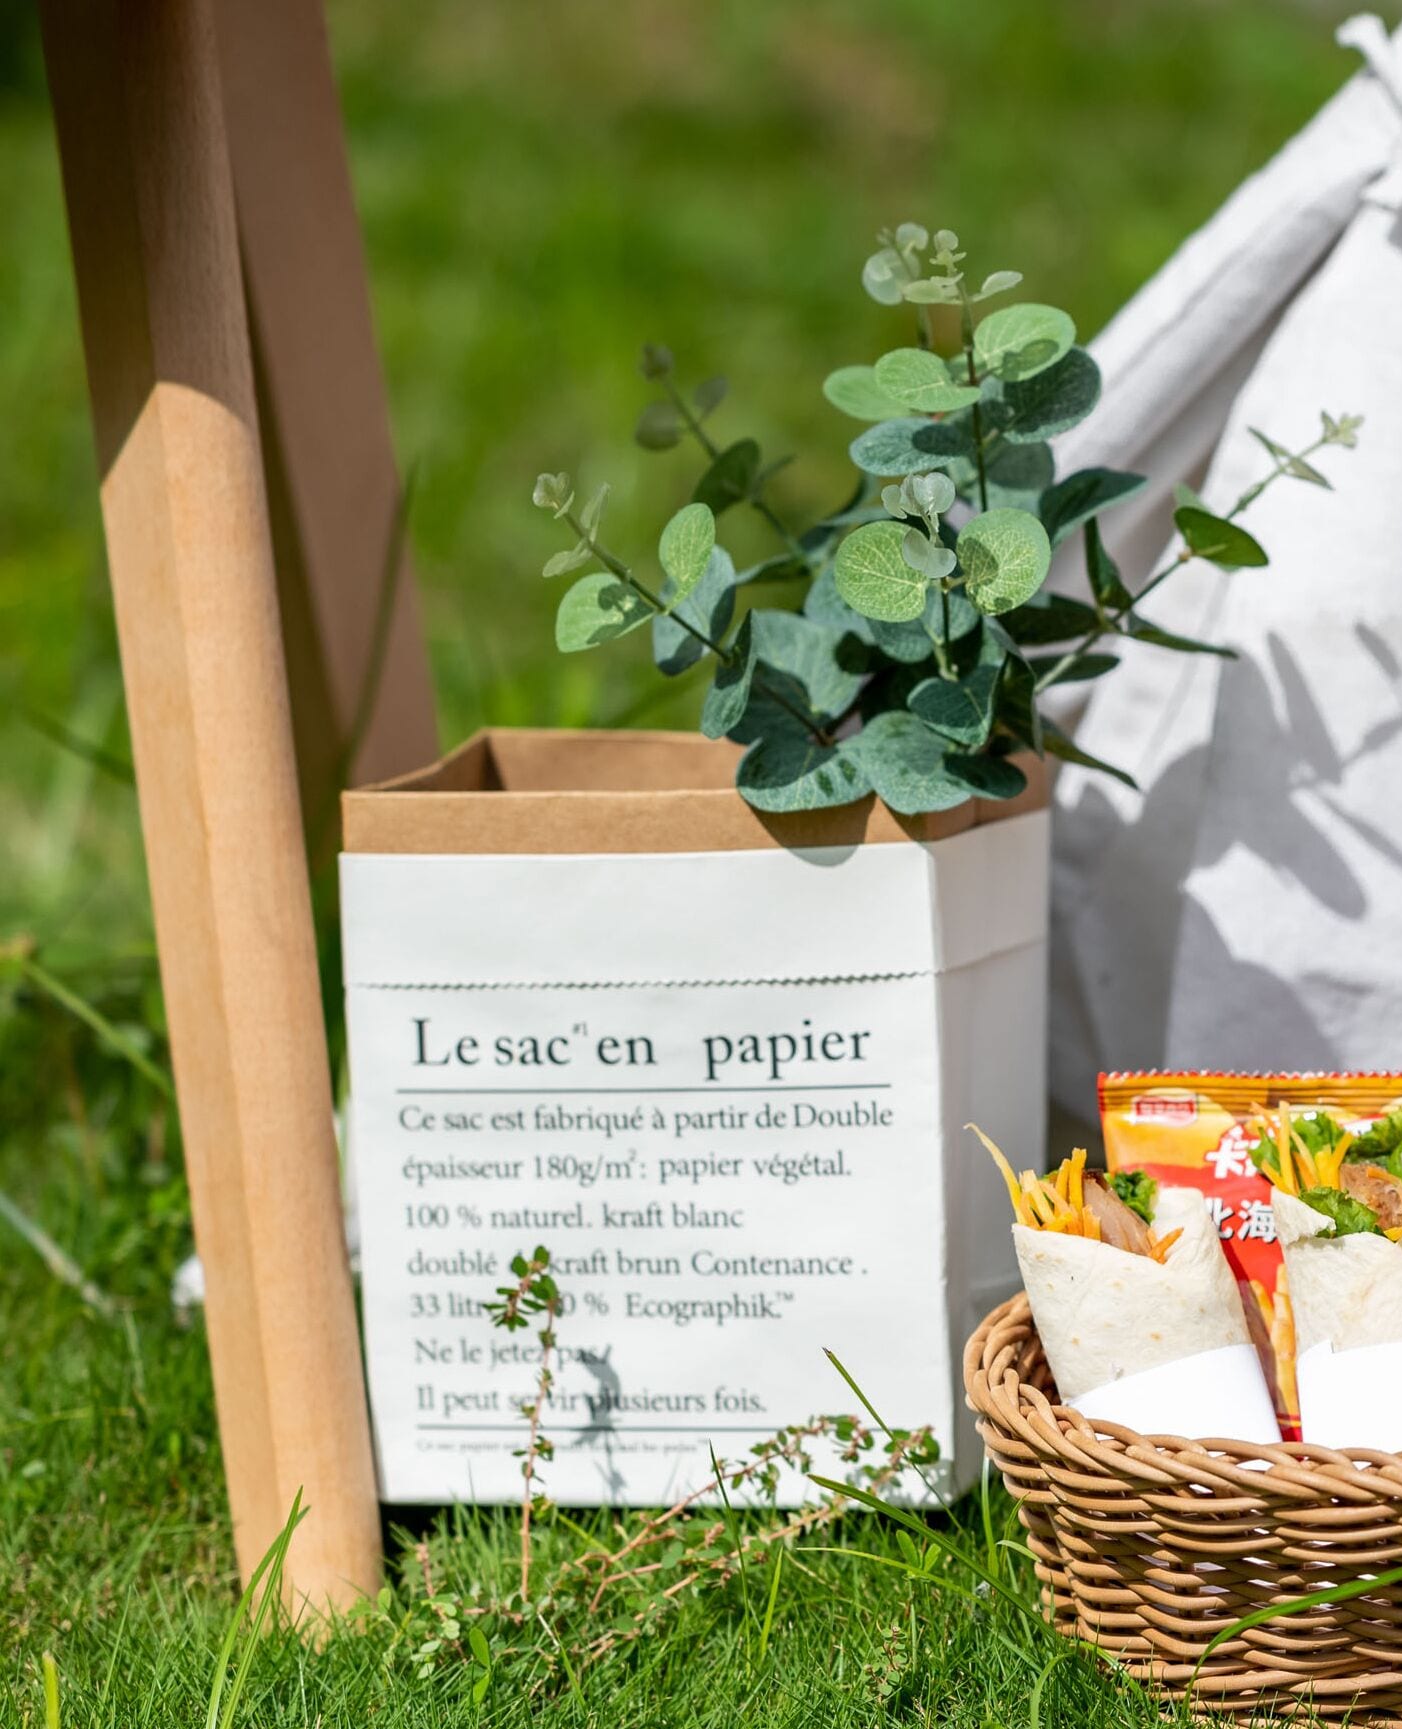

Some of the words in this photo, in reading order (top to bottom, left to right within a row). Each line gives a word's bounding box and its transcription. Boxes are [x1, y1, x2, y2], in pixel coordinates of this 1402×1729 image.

[411, 1016, 481, 1067] Le
[596, 1032, 659, 1066] en
[701, 1018, 872, 1081] papier
[398, 1105, 437, 1132] Ce
[443, 1112, 483, 1132] sac
[490, 1109, 527, 1132] est
[533, 1103, 645, 1139] fabriqué
[650, 1106, 667, 1131] à
[674, 1104, 750, 1139] partir
[754, 1101, 788, 1130] de
[792, 1100, 894, 1129] Double
[401, 1154, 524, 1188] épaisseur
[658, 1151, 745, 1186] papier
[752, 1148, 852, 1186] végétal.
[405, 1204, 451, 1229] 100
[456, 1204, 483, 1229] %
[489, 1201, 593, 1230] naturel.
[601, 1201, 665, 1229] kraft
[671, 1201, 744, 1229] blanc
[406, 1249, 499, 1277] doublé
[616, 1249, 682, 1277] brun
[411, 1293, 442, 1318] 33
[582, 1292, 610, 1316] %
[414, 1338, 454, 1365] Ne
[459, 1337, 483, 1365] le
[417, 1384, 435, 1411] Il
[442, 1389, 500, 1418] peut
[713, 1386, 768, 1414] fois.
